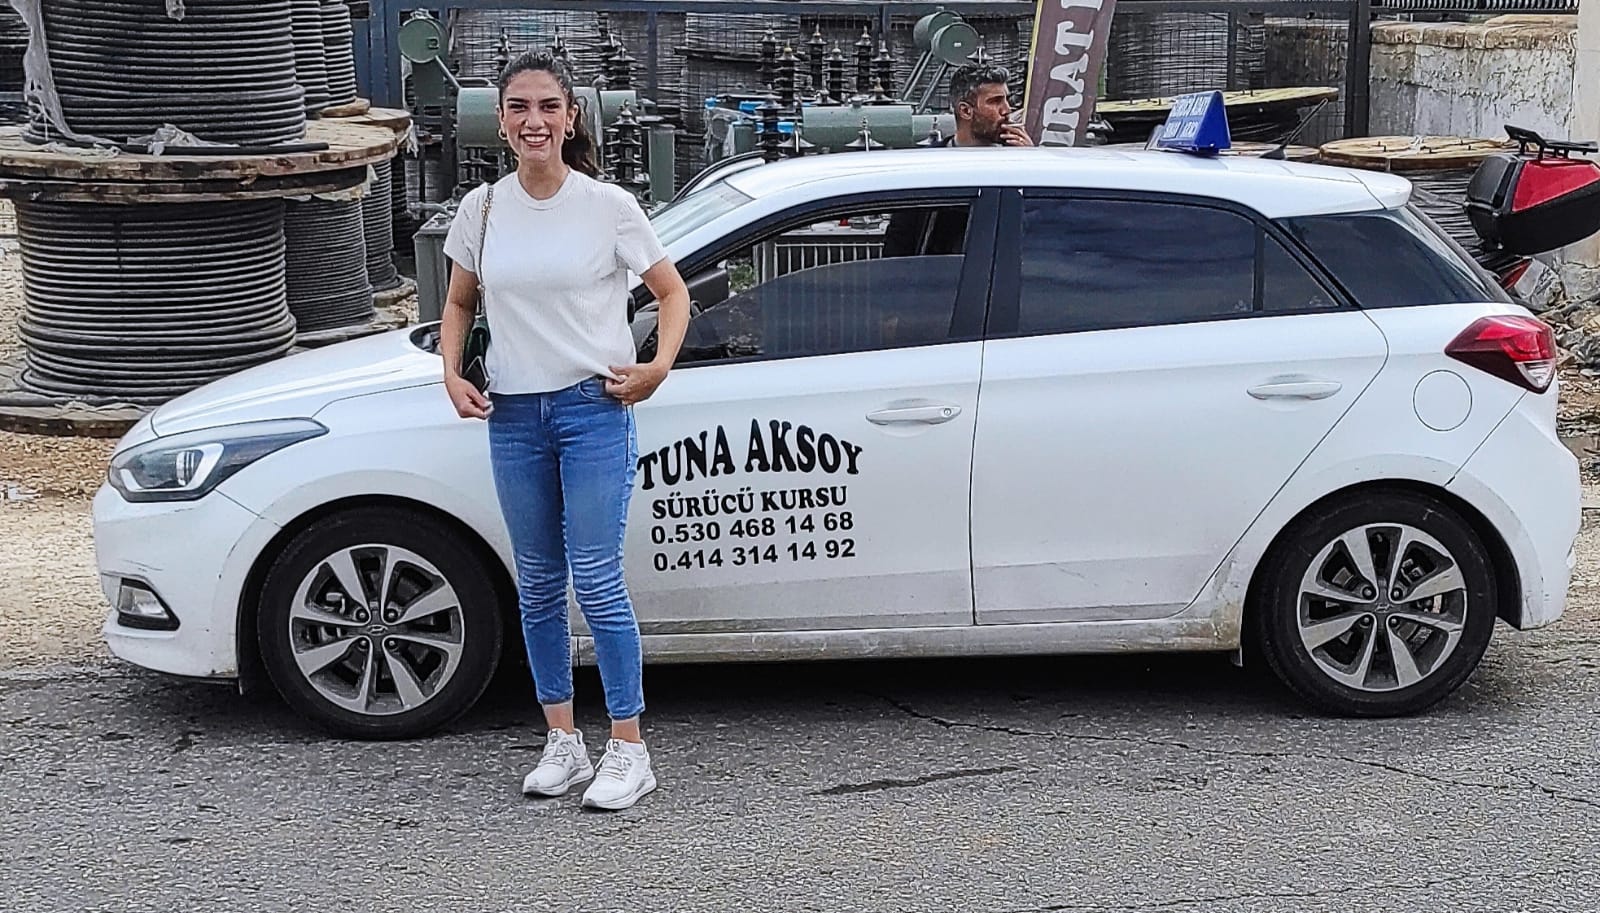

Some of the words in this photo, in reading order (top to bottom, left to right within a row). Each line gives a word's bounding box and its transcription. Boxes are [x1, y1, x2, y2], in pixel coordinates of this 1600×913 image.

[636, 425, 736, 490] TUNA
[744, 418, 863, 475] AKSOY
[652, 487, 755, 520] SÜRÜCÜ
[760, 485, 848, 512] KURSU
[651, 521, 721, 544] 0.530
[729, 517, 776, 538] 468
[784, 514, 815, 534] 14
[823, 511, 854, 531] 68
[653, 549, 723, 572] 0.414
[732, 543, 779, 566] 314
[787, 541, 817, 562] 14
[824, 538, 856, 559] 92
